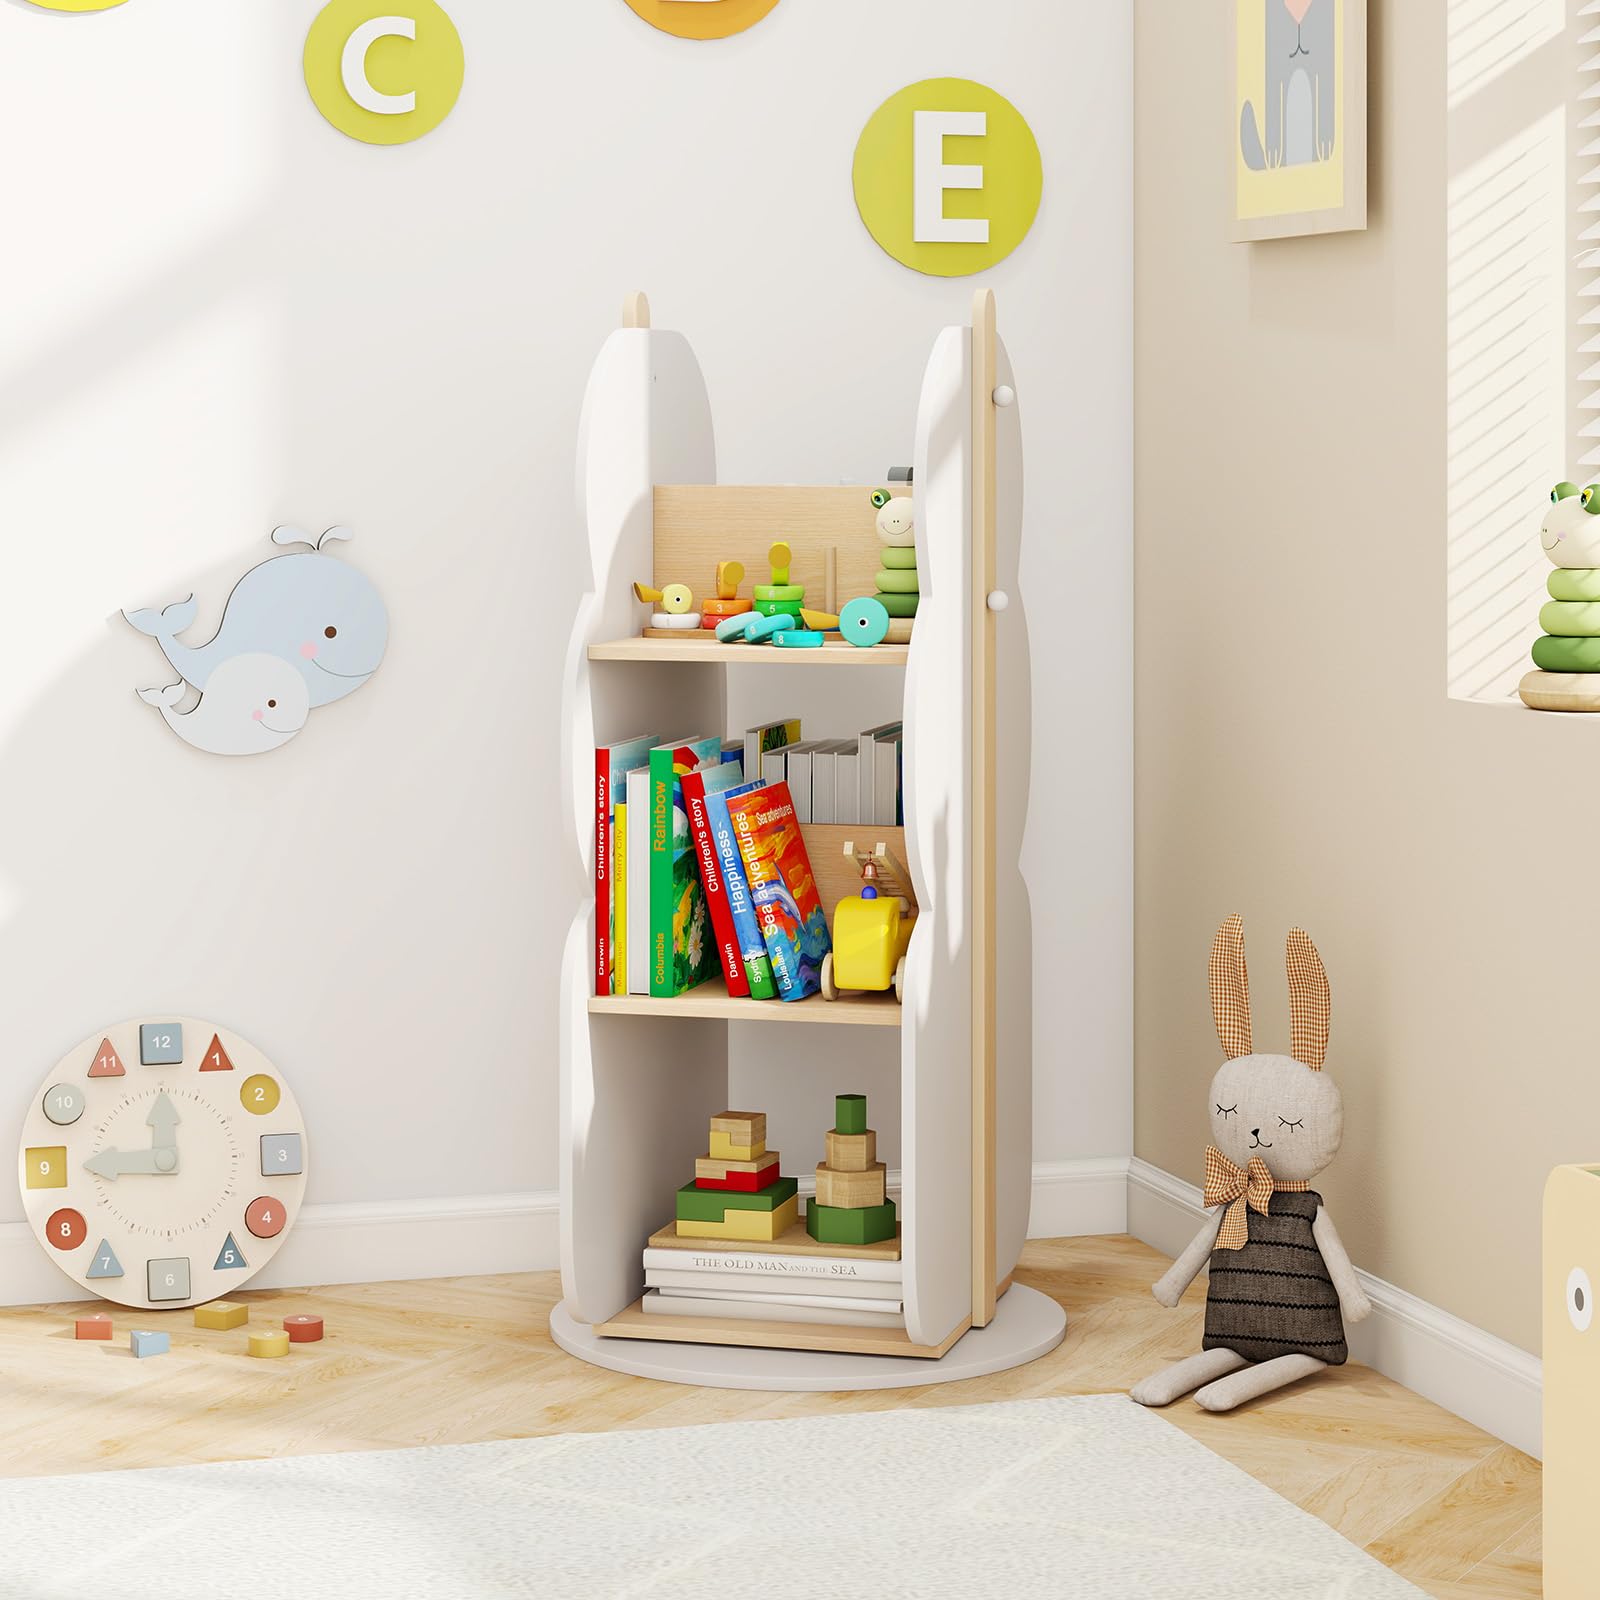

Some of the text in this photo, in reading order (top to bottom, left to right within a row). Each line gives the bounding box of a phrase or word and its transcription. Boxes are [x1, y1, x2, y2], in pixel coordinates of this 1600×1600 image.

[341, 15, 416, 115] C
[913, 110, 990, 243] E
[716, 603, 723, 614] 3
[769, 604, 776, 614] 5
[778, 634, 784, 645] 8
[653, 781, 666, 852] Rainbow
[755, 803, 793, 826] Sea adventures
[597, 775, 606, 880] Children's story
[616, 828, 624, 849] City
[690, 798, 719, 892] Children's story
[736, 812, 770, 900] adventures
[718, 830, 747, 914] Happiness
[761, 903, 779, 936] Sea
[655, 933, 665, 985] Columbia
[724, 943, 739, 978] Darwin
[748, 948, 762, 983] Sydny
[774, 946, 793, 990] Louisiana
[152, 1036, 171, 1049] 12
[99, 1055, 117, 1069] 11
[212, 1053, 220, 1066] 1
[254, 1087, 264, 1101] 2
[55, 1096, 73, 1110] 10
[277, 1149, 287, 1162] 3
[40, 1160, 50, 1175] 9
[262, 1210, 272, 1223] 4
[60, 1222, 71, 1237] 8
[101, 1257, 110, 1270] 7
[224, 1250, 234, 1264] 5
[692, 1257, 721, 1267] THE
[724, 1259, 754, 1269] OLD
[757, 1261, 788, 1271] MAN
[788, 1264, 808, 1272] AND
[831, 1264, 857, 1275] SEA
[165, 1273, 174, 1287] 6
